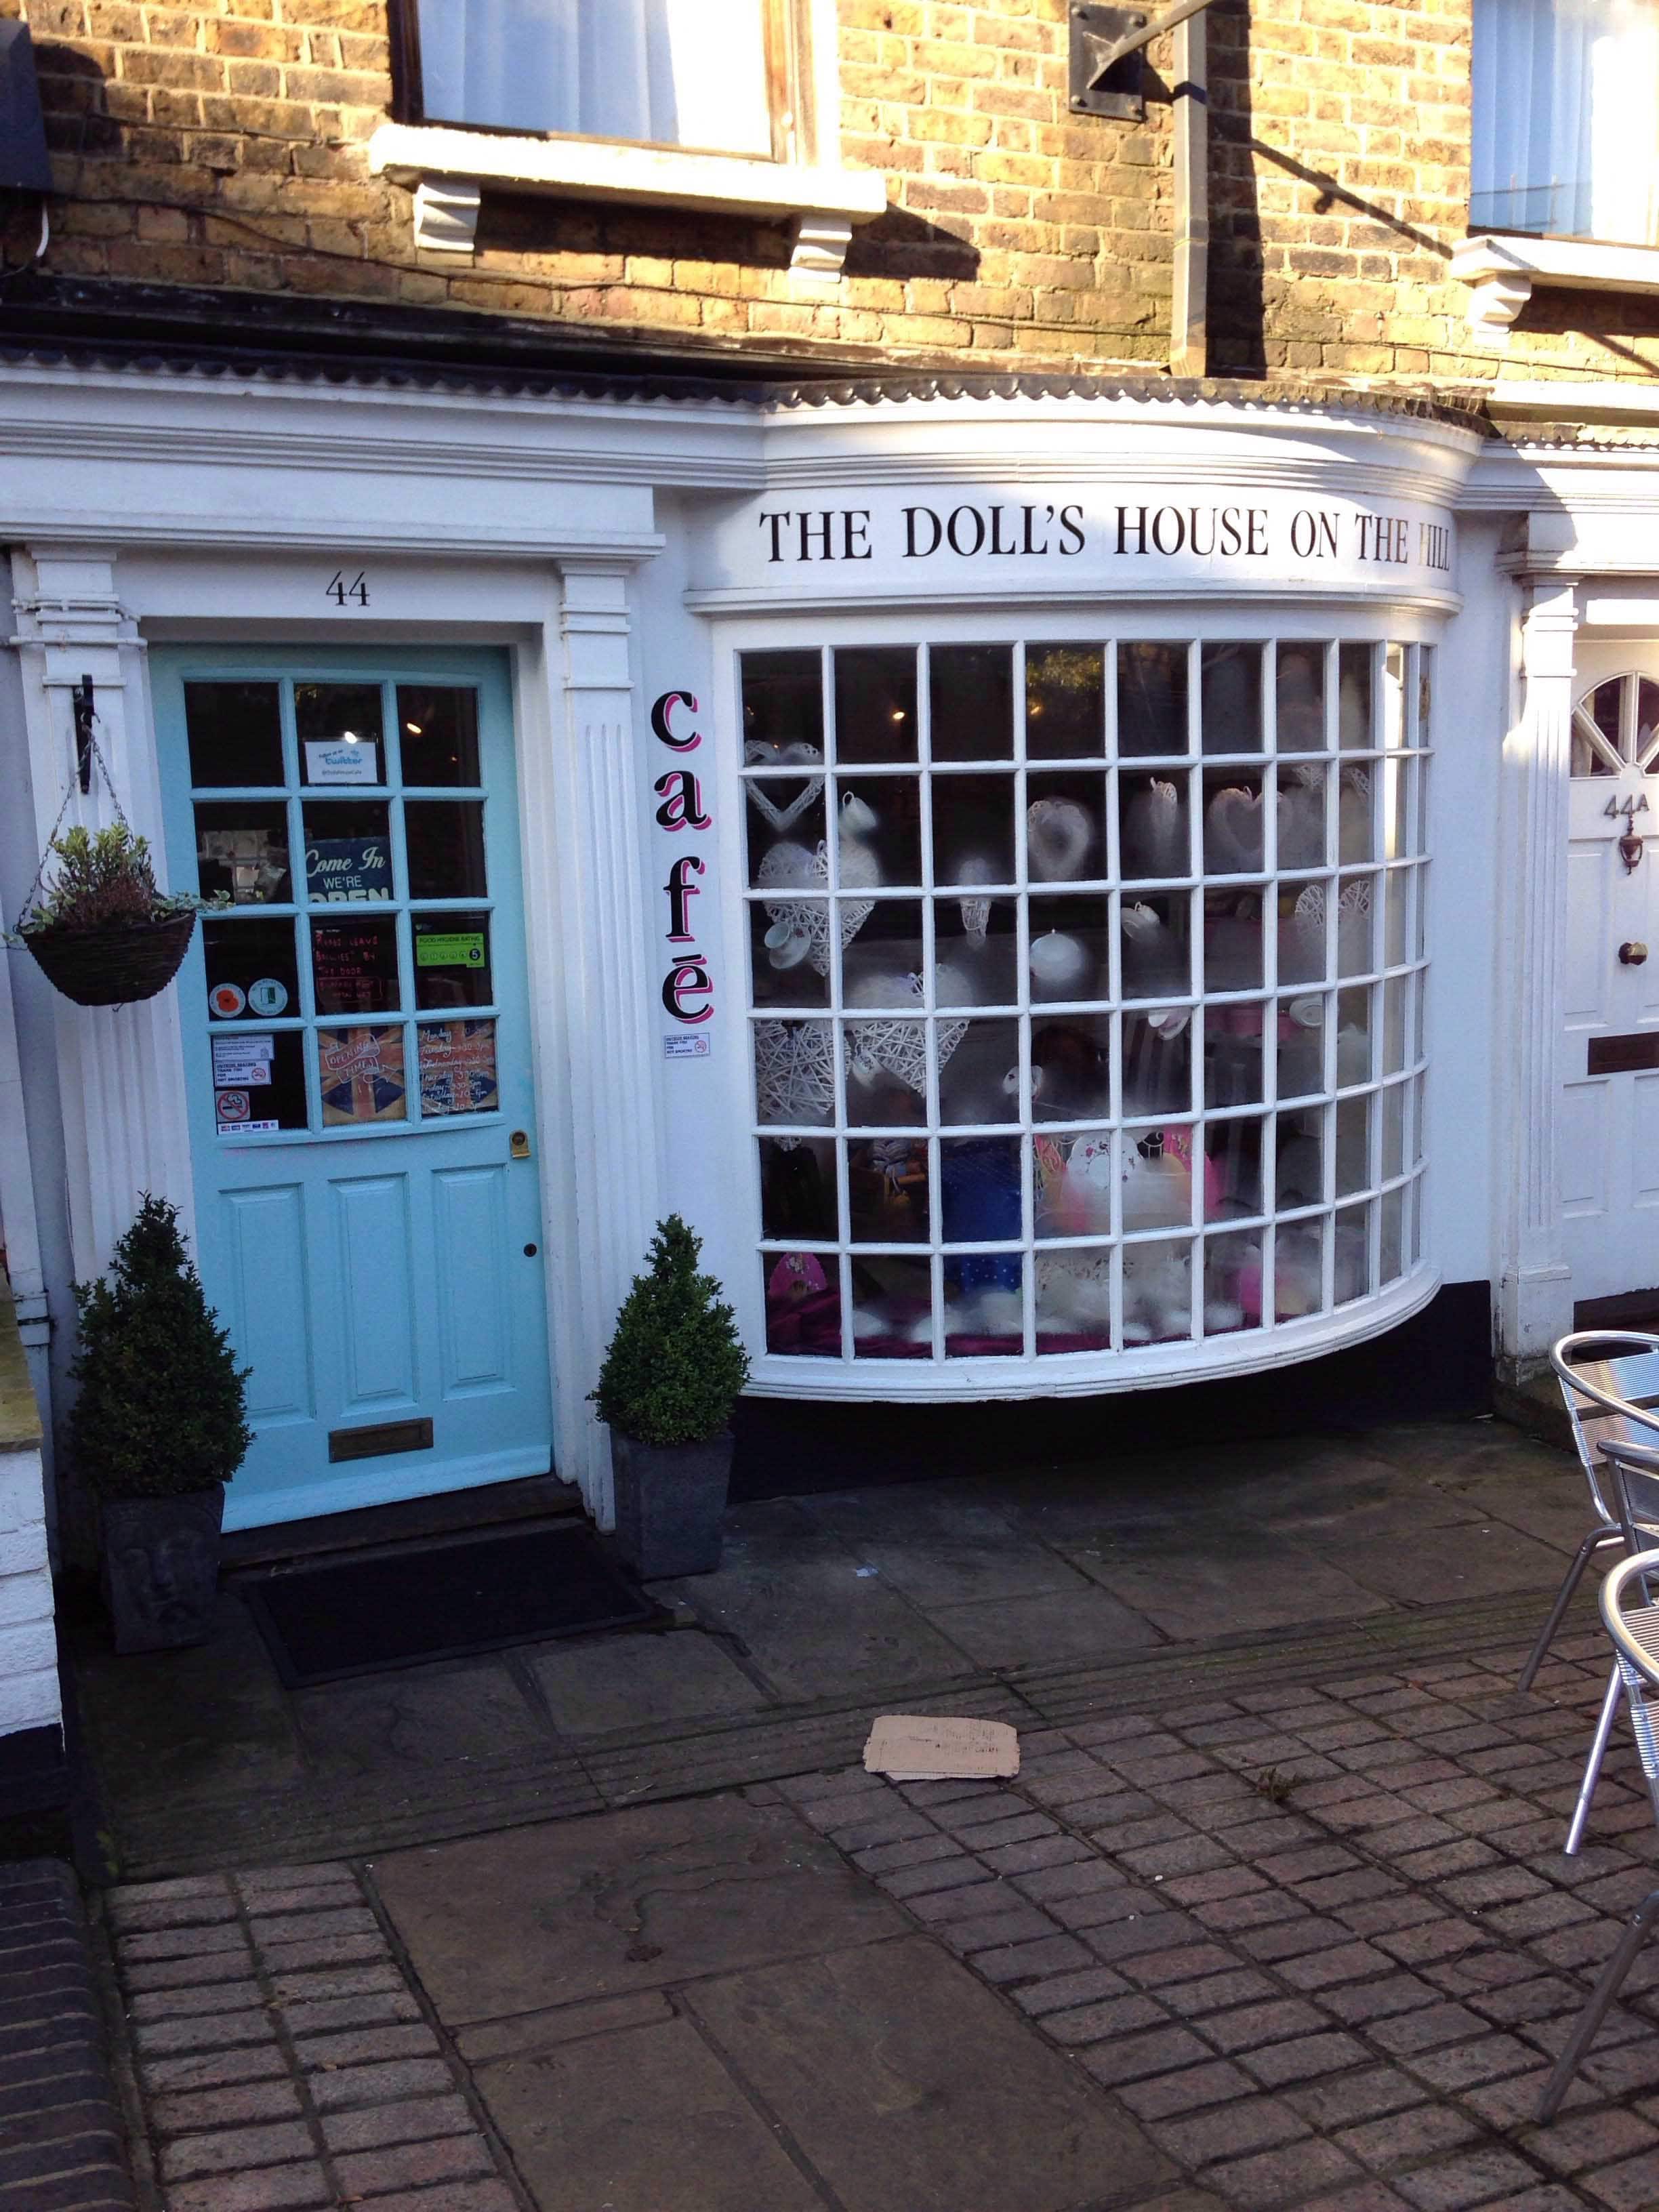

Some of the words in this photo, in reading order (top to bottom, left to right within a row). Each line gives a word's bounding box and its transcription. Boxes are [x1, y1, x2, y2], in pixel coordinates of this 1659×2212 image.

[759, 510, 872, 562] THE
[901, 505, 1086, 557] DOLL'S
[1113, 506, 1269, 556] HOUSE
[1290, 510, 1340, 558] ON
[1355, 513, 1409, 564] THE
[1419, 523, 1450, 571] HILL
[326, 571, 370, 607] 44
[325, 756, 363, 765] twitter
[1603, 794, 1650, 819] 44A
[306, 849, 352, 878] Come
[359, 846, 386, 870] In
[323, 875, 363, 890] WE'RE
[472, 949, 478, 959] 5
[422, 1028, 452, 1042] Monday
[329, 1040, 370, 1065] OPENING
[345, 1059, 374, 1077] TIMES
[422, 1070, 454, 1084] Thursday
